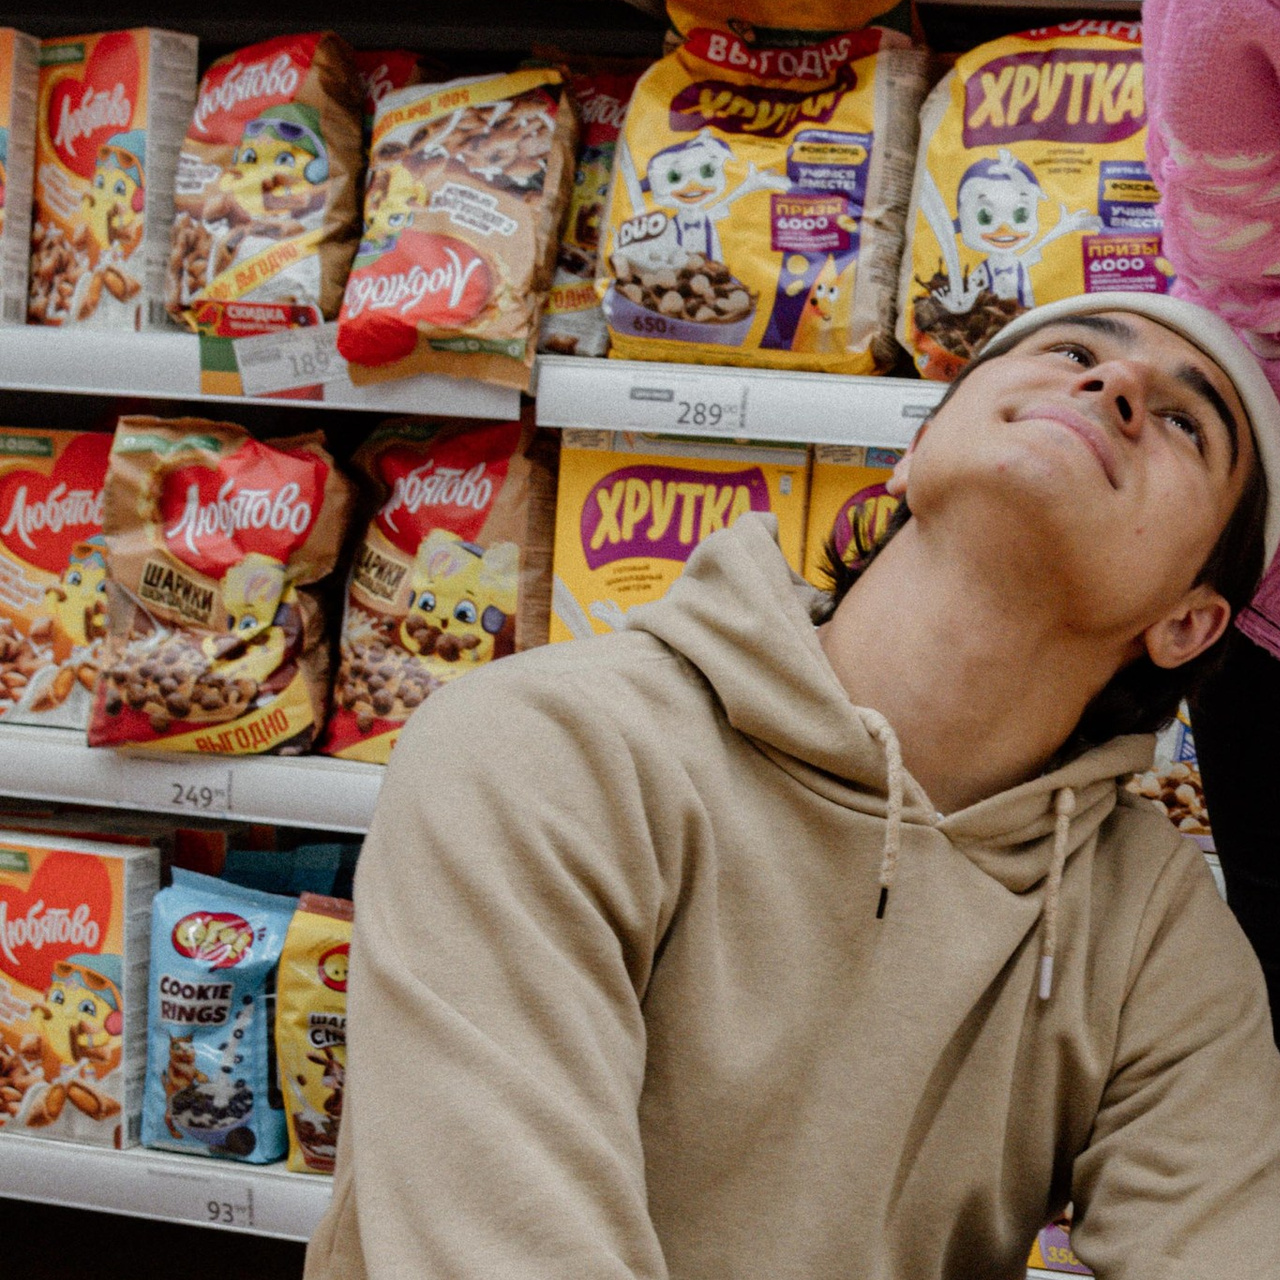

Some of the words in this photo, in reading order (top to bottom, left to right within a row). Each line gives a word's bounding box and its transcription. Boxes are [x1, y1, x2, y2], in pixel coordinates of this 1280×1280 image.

[967, 60, 1145, 129] ХРУТКА
[619, 211, 667, 246] DUO
[776, 215, 829, 231] 6000
[1087, 243, 1159, 259] ПРИЗЫ
[1089, 257, 1146, 273] 6000
[226, 305, 285, 322] СКИДКА
[676, 401, 723, 427] 289
[167, 480, 312, 554] Любятово
[143, 562, 215, 613] ШАРИКИ
[195, 706, 290, 754] ВЫГОДНО
[171, 780, 215, 809] 249
[159, 974, 233, 1003] COOKIE
[159, 1000, 231, 1025] RINGS
[206, 1200, 235, 1223] 93
